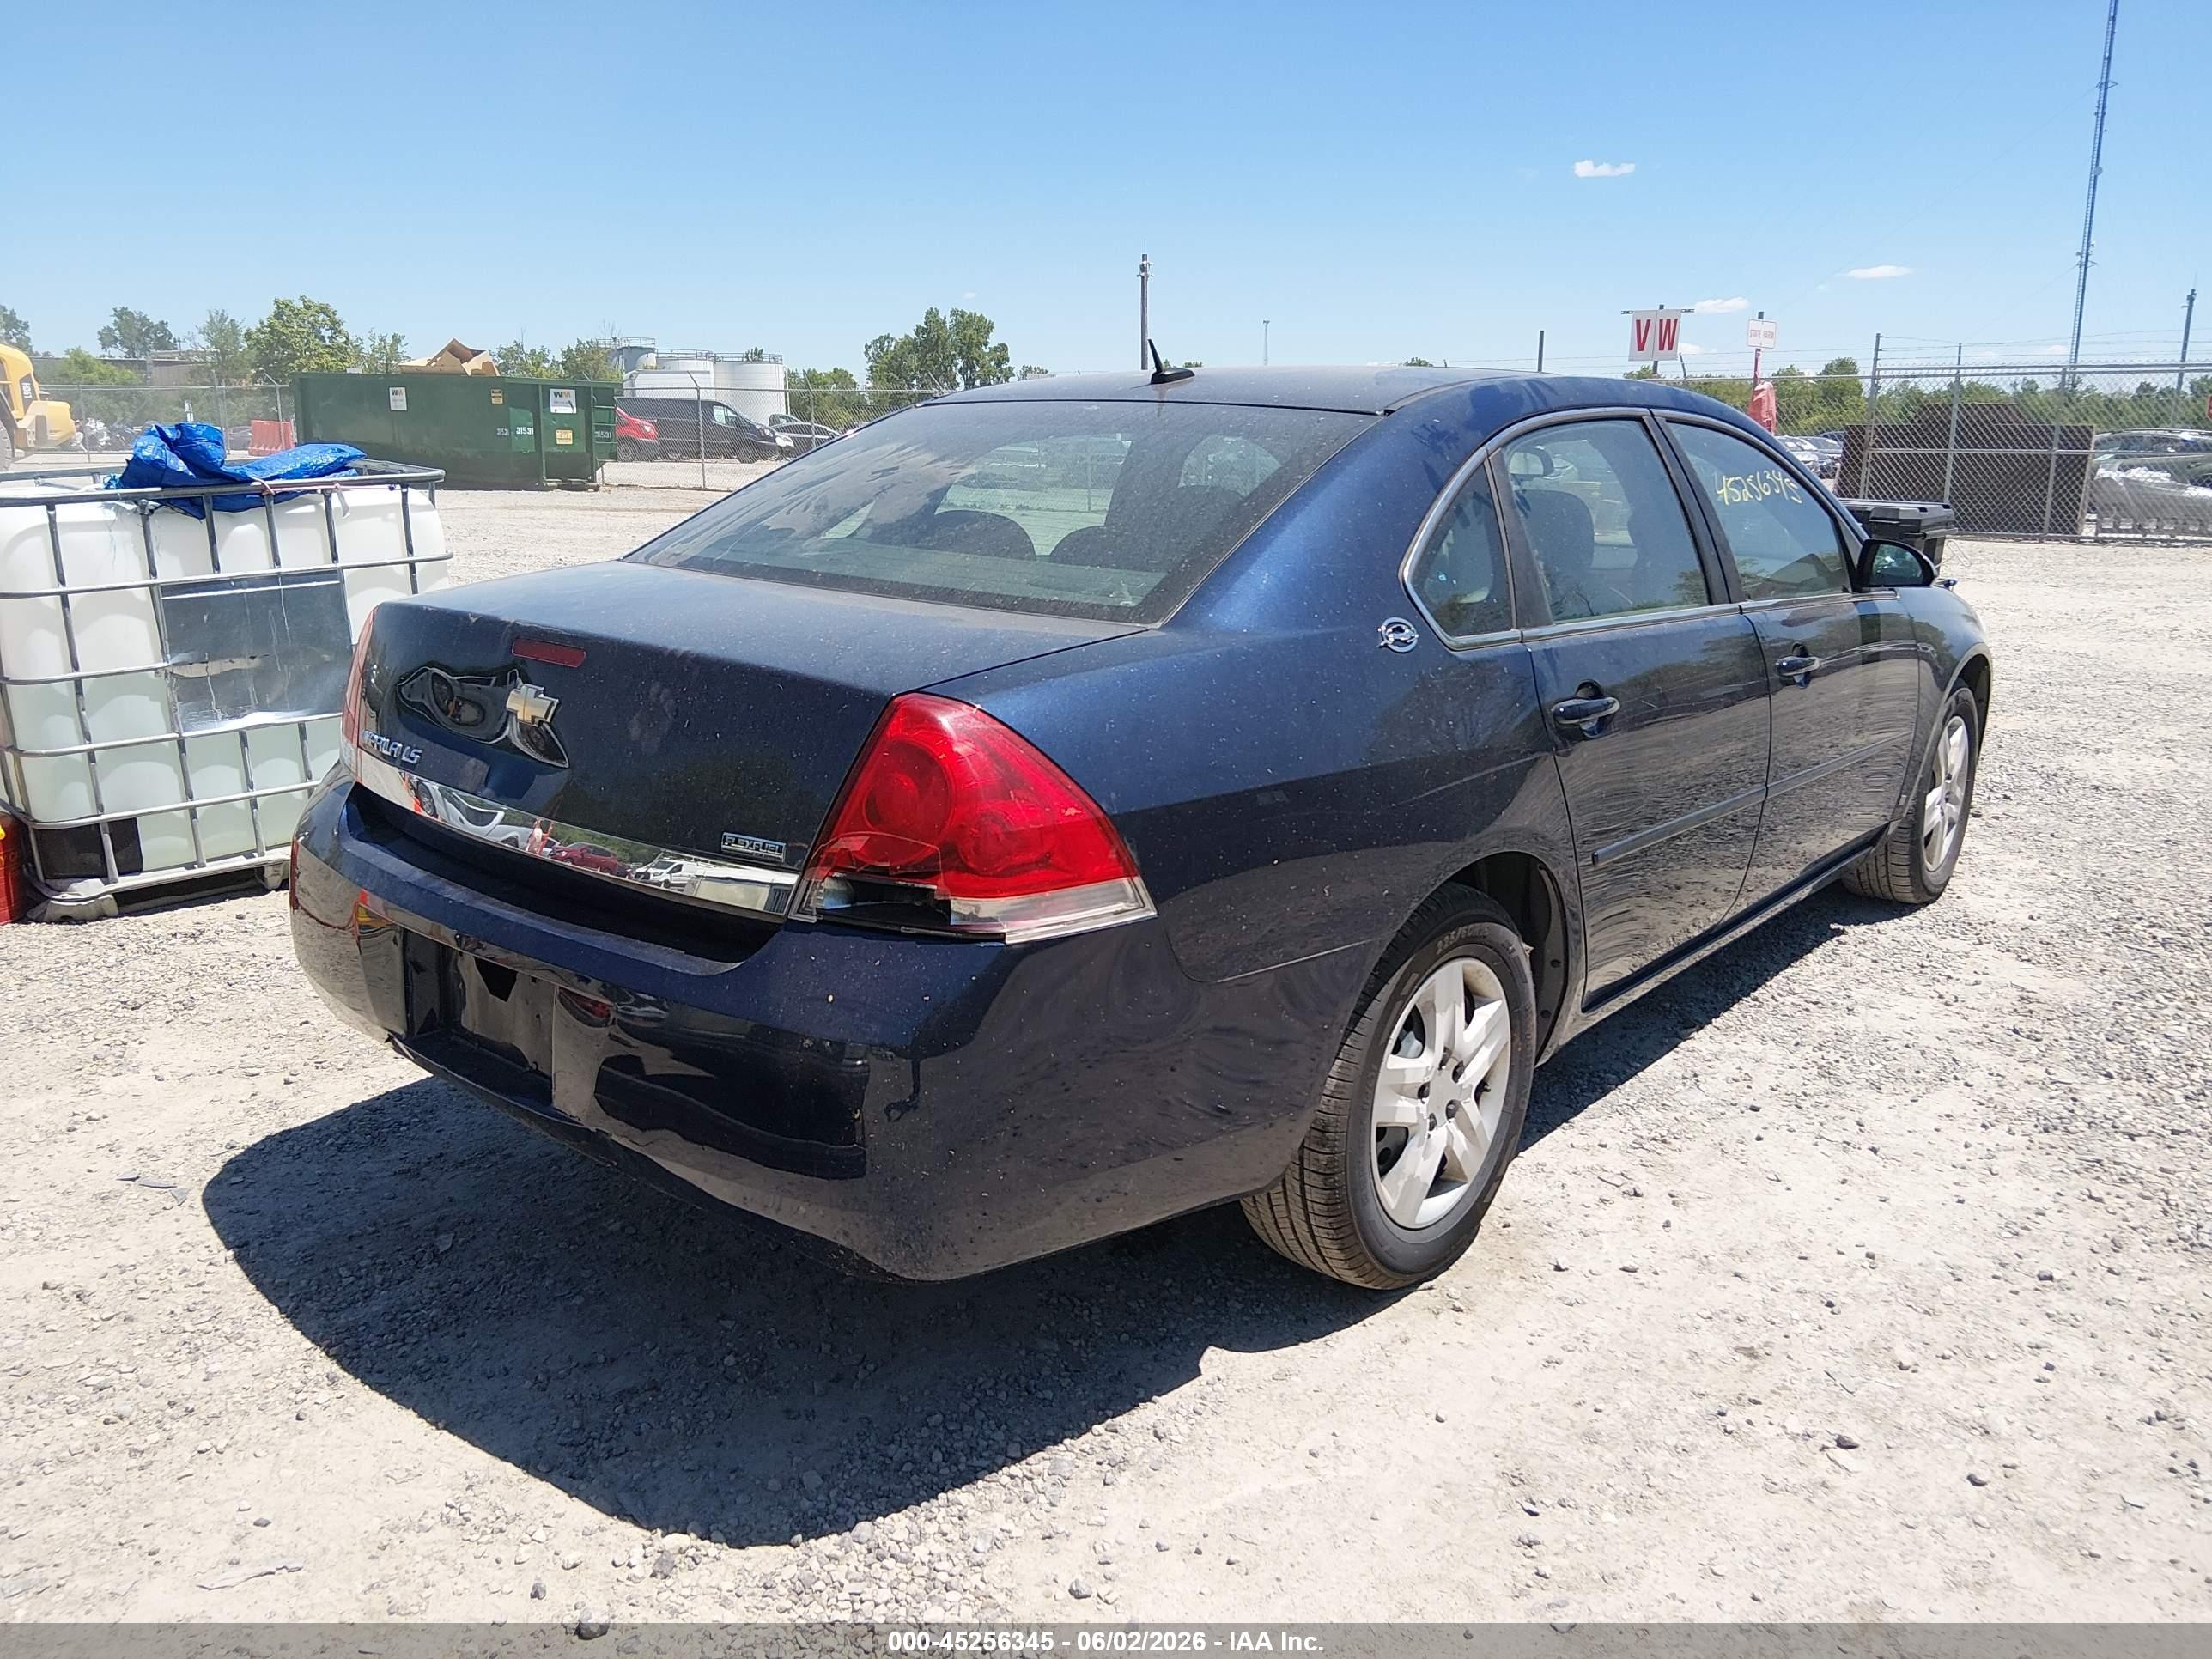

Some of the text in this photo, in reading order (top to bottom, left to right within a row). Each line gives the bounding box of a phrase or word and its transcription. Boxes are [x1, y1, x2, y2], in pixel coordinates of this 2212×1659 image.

[516, 427, 533, 435] 31531
[1714, 470, 1802, 506] 45256345
[401, 745, 422, 764] LS
